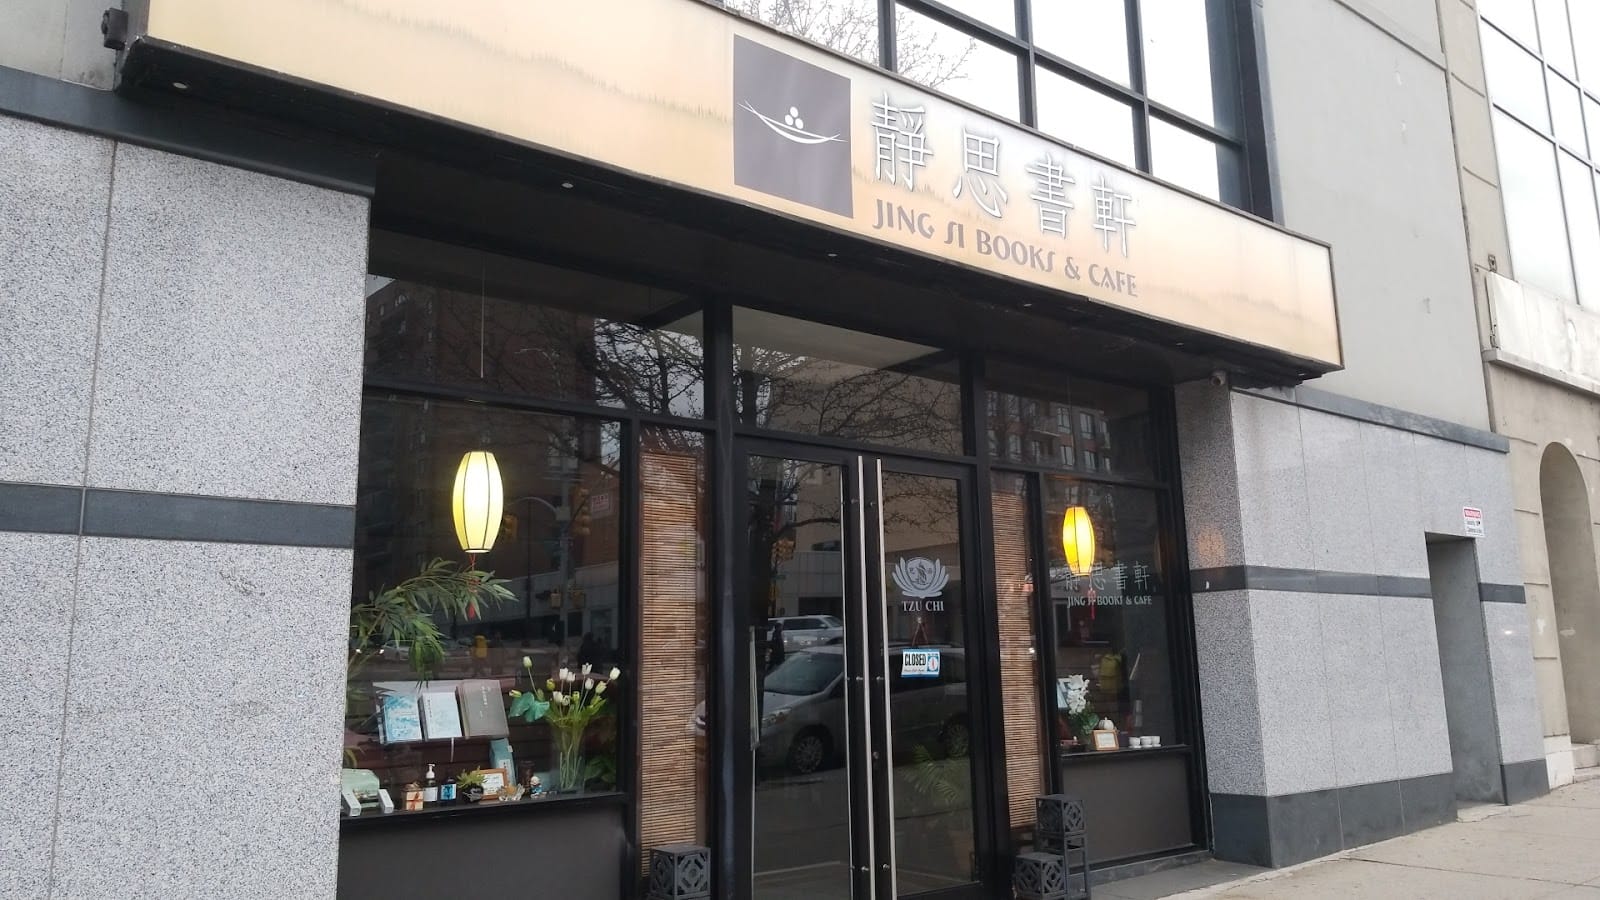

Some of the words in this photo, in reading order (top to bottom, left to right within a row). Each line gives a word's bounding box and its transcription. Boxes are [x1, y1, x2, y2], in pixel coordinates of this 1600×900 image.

[870, 91, 1137, 258] 靜思書軒
[872, 198, 935, 239] JING
[944, 220, 965, 249] SI
[976, 228, 1056, 273] BOOKS
[1064, 256, 1081, 281] &
[1088, 264, 1138, 297] CAFE
[902, 600, 922, 611] TZU
[925, 600, 944, 611] CHI
[1067, 596, 1086, 608] JING
[1097, 595, 1123, 606] BOOKS
[1125, 596, 1132, 606] &
[1133, 595, 1152, 605] CAFE
[905, 653, 926, 666] CLOSED
